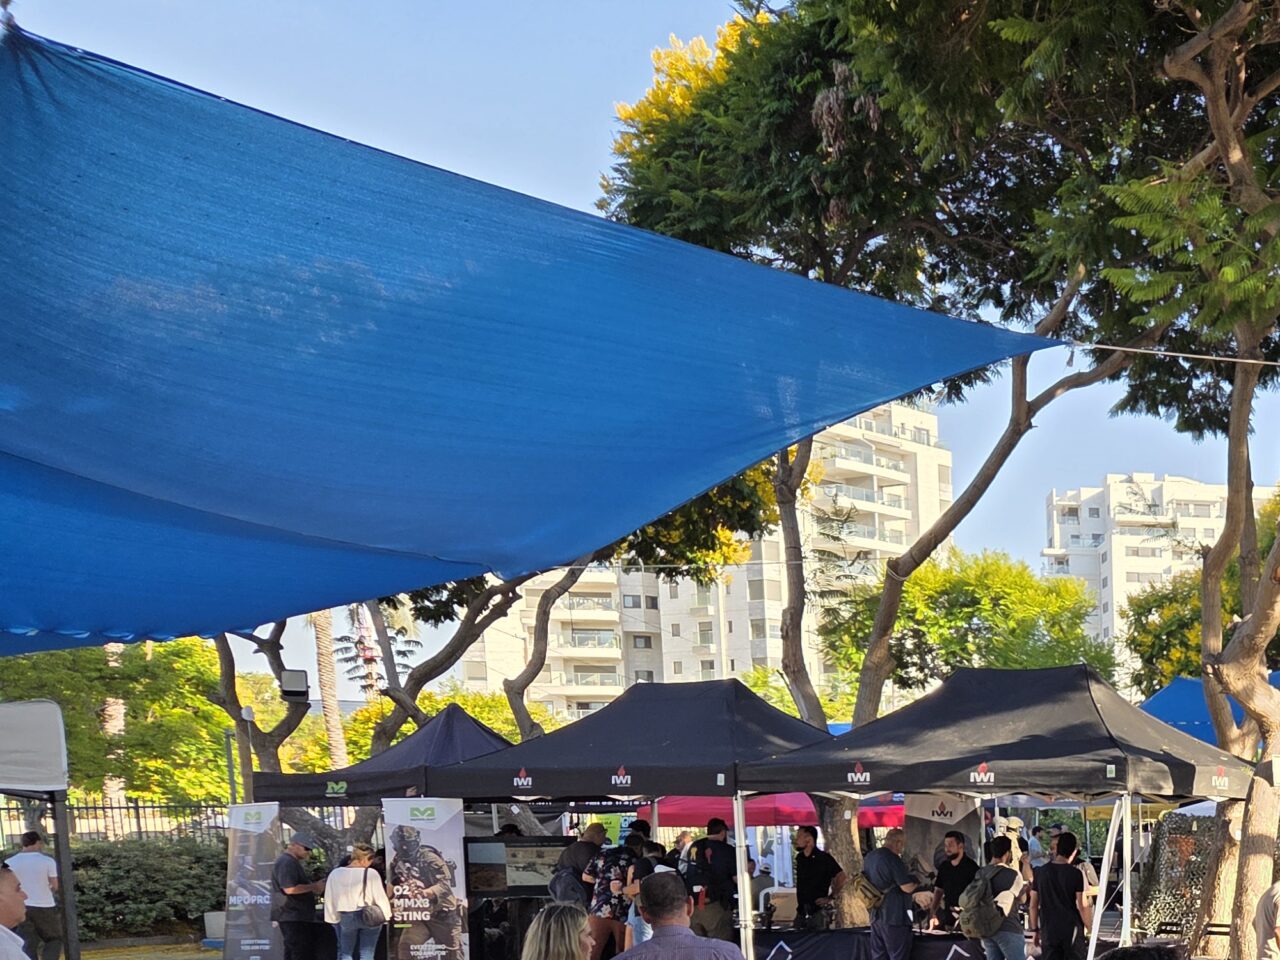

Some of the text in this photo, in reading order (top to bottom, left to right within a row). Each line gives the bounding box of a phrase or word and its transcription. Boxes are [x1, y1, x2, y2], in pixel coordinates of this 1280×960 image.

[513, 777, 532, 786] IWI
[611, 775, 631, 785] IWI
[847, 772, 871, 782] IWI
[969, 772, 995, 782] IWI
[393, 911, 431, 921] STING
